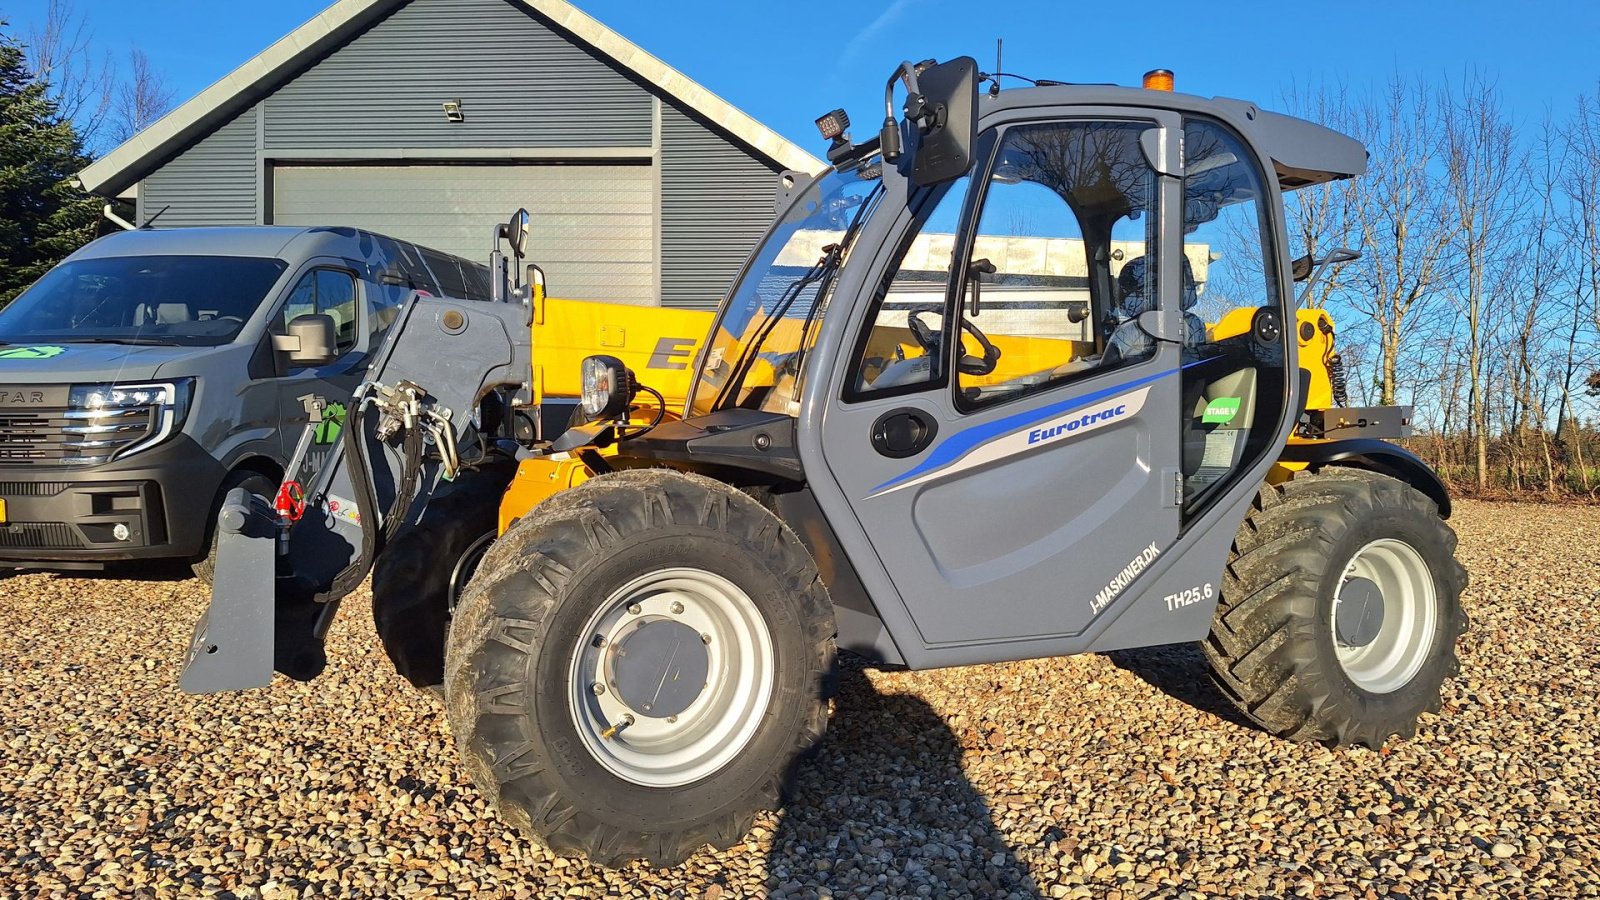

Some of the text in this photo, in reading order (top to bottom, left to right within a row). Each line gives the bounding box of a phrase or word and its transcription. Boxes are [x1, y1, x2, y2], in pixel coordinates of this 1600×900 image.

[1028, 404, 1125, 444] Eurotrac
[1207, 407, 1237, 416] STAGE V
[1089, 540, 1161, 615] J-MASKINER.DK
[1163, 583, 1213, 612] TH25.6
